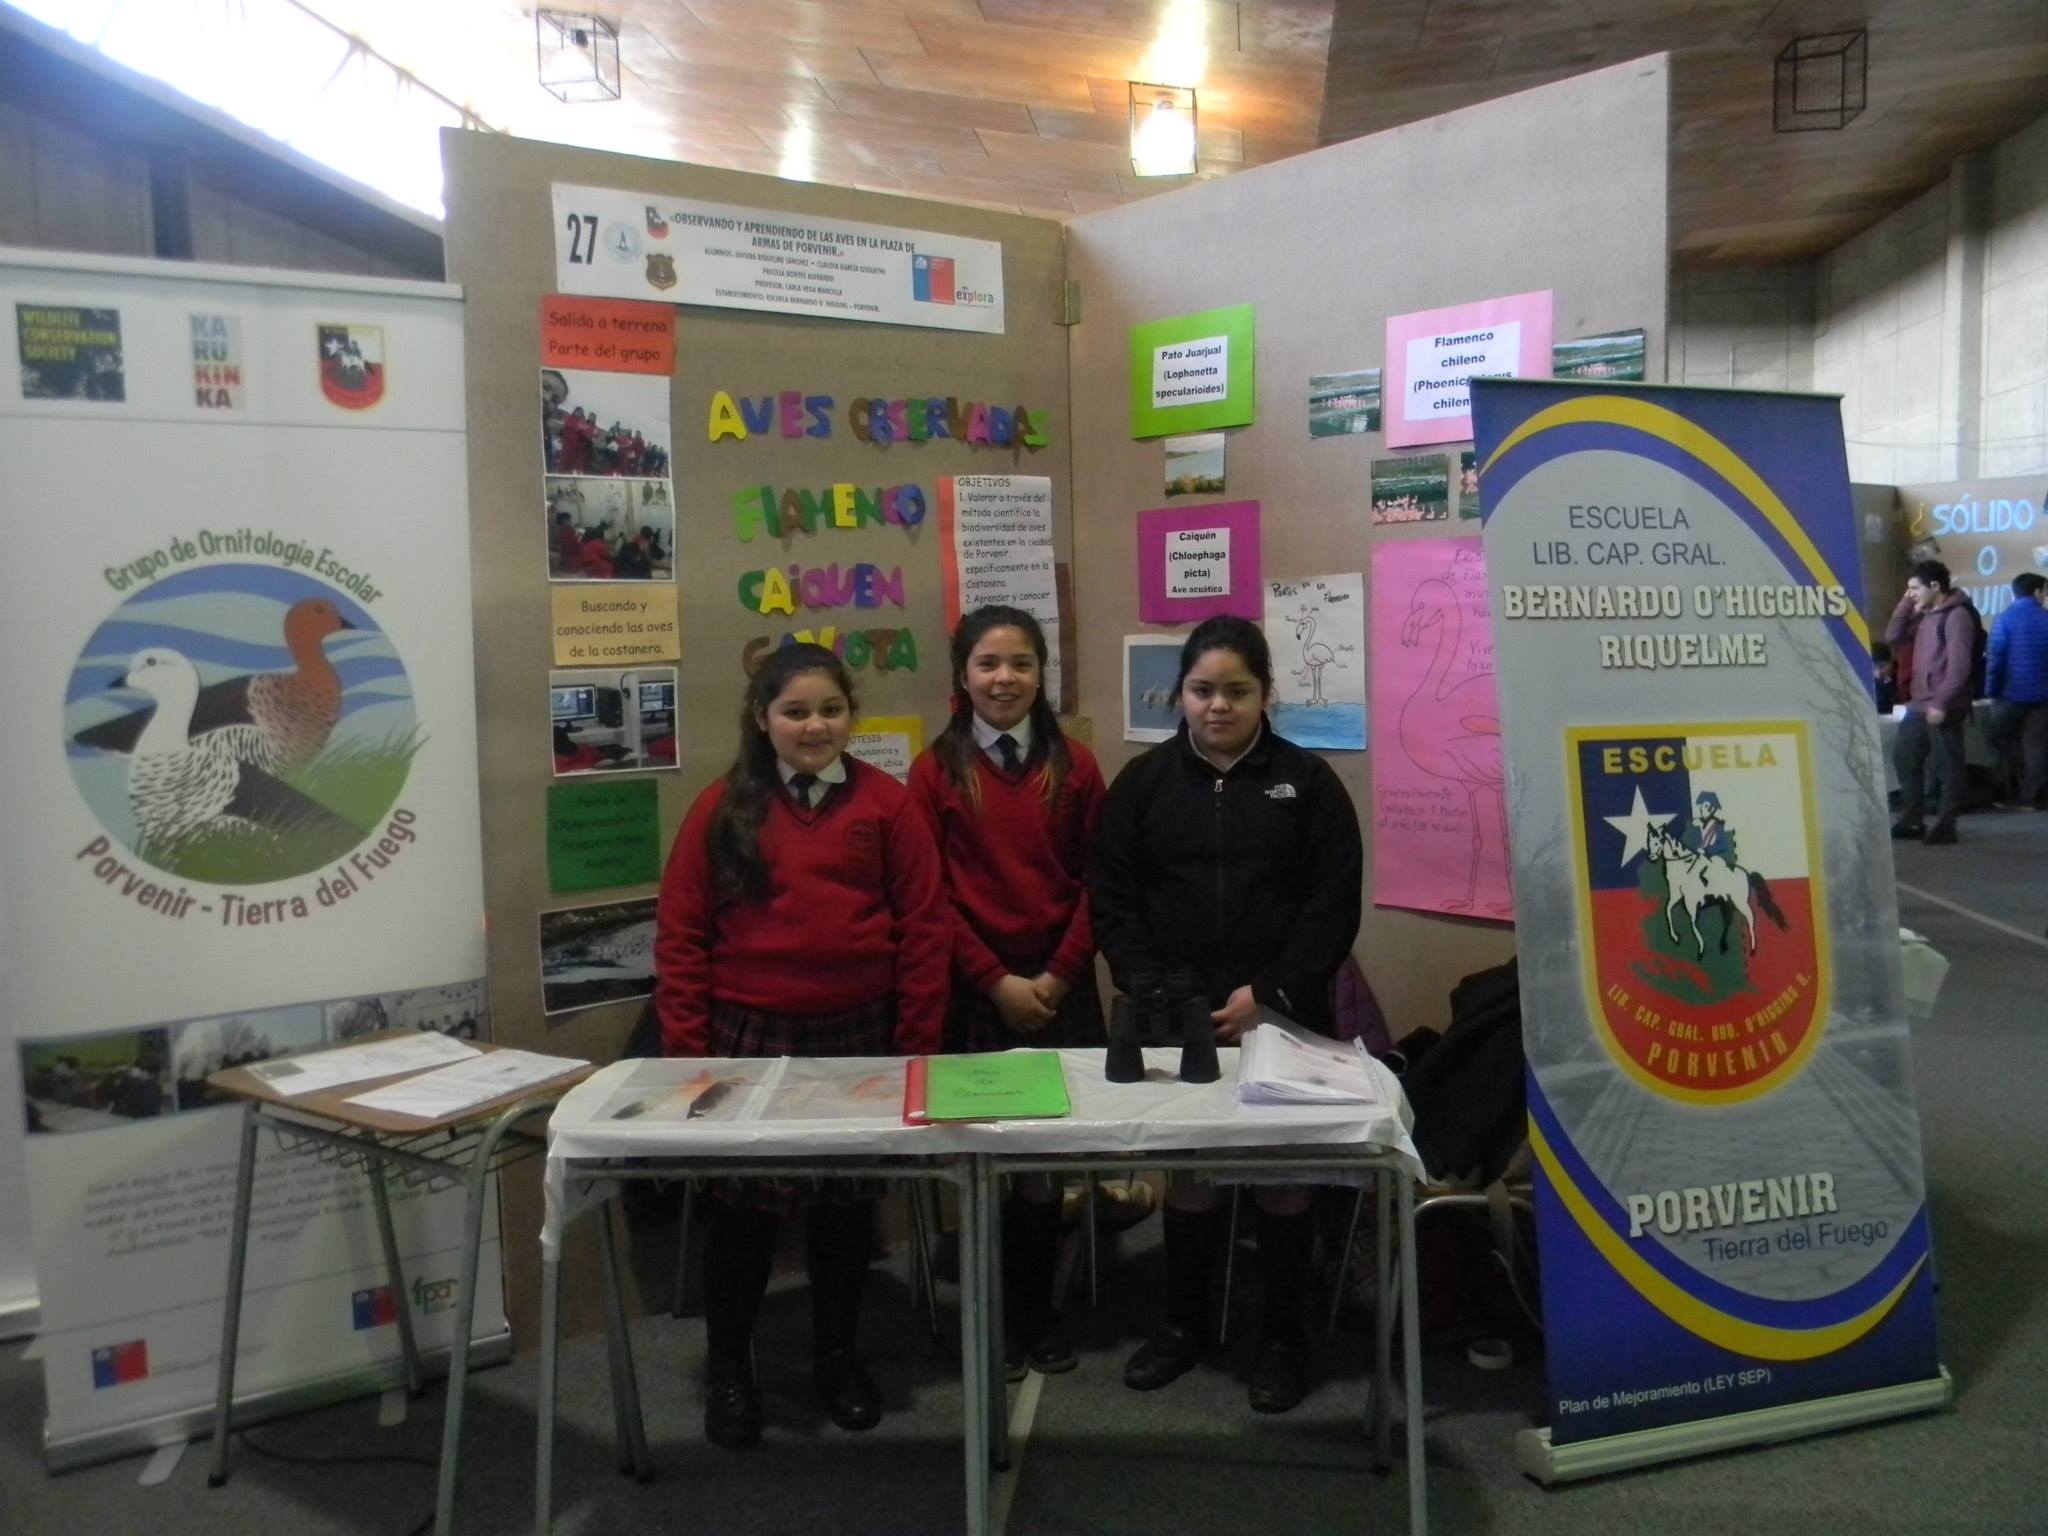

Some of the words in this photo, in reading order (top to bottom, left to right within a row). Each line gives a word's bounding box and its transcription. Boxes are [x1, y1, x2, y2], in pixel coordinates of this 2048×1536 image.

[567, 213, 598, 265] 27
[737, 220, 745, 233] Y
[745, 222, 805, 241] APRENDIENDO
[807, 228, 818, 240] DE
[820, 230, 834, 244] LAS
[836, 232, 855, 246] AVES
[857, 235, 868, 248] EN
[870, 236, 880, 249] LA
[881, 238, 904, 252] PLAZA
[906, 242, 916, 254] DE
[752, 236, 780, 251] ARMAS
[783, 239, 794, 252] DE
[192, 314, 229, 338] KA
[549, 311, 594, 329] Salida
[598, 319, 606, 329] a
[612, 316, 667, 334] terreno
[194, 338, 229, 361] RU
[1435, 331, 1494, 348] Flamenco
[549, 340, 588, 358] Parte
[594, 344, 616, 361] del
[619, 348, 661, 364] grupo
[1161, 350, 1183, 362] Pato
[1441, 354, 1486, 368] chileno
[196, 364, 242, 385] KIN
[1163, 366, 1218, 382] (Lophonetta
[198, 386, 233, 409] KA
[1155, 383, 1225, 399] specularioides)
[707, 390, 835, 442] AVES
[848, 395, 1051, 448] OBSERVADAS
[1568, 505, 1691, 530] ESCUELA
[1533, 541, 1579, 566] LIB.
[1587, 542, 1643, 567] CAP.
[1653, 542, 1727, 567] GRAL.
[1977, 544, 1997, 577] O
[104, 549, 169, 592] Grupo
[171, 535, 199, 561] de
[313, 549, 384, 605] Escolar
[1184, 567, 1211, 580] picta)
[1171, 585, 1187, 594] Ave
[1504, 584, 1683, 619] BERNARDO
[582, 600, 638, 613] Buscando
[640, 603, 648, 615] y
[557, 620, 623, 636] conociendo
[627, 619, 645, 634] las
[646, 622, 674, 634] aves
[569, 645, 585, 659] de
[588, 644, 599, 657] la
[602, 642, 665, 657] costanera.
[1600, 633, 1767, 670] RIQUELME
[1601, 743, 1781, 776] ESCUELA
[76, 835, 197, 919] Porvenir
[220, 893, 309, 927] Tierra
[316, 866, 359, 908] del
[355, 807, 417, 881] Fuego
[1647, 1030, 1788, 1078] PORVENIR
[1627, 1171, 1838, 1240] PORVENIR
[1702, 1234, 1771, 1264] Tierra
[1777, 1227, 1811, 1255] del
[1818, 1218, 1889, 1248] Fuego
[1559, 1396, 1590, 1415] Plan
[1592, 1394, 1610, 1411] de
[1613, 1380, 1701, 1409] Mejoramiento
[1703, 1373, 1735, 1395] (LEY
[1737, 1368, 1772, 1389] SEP)
